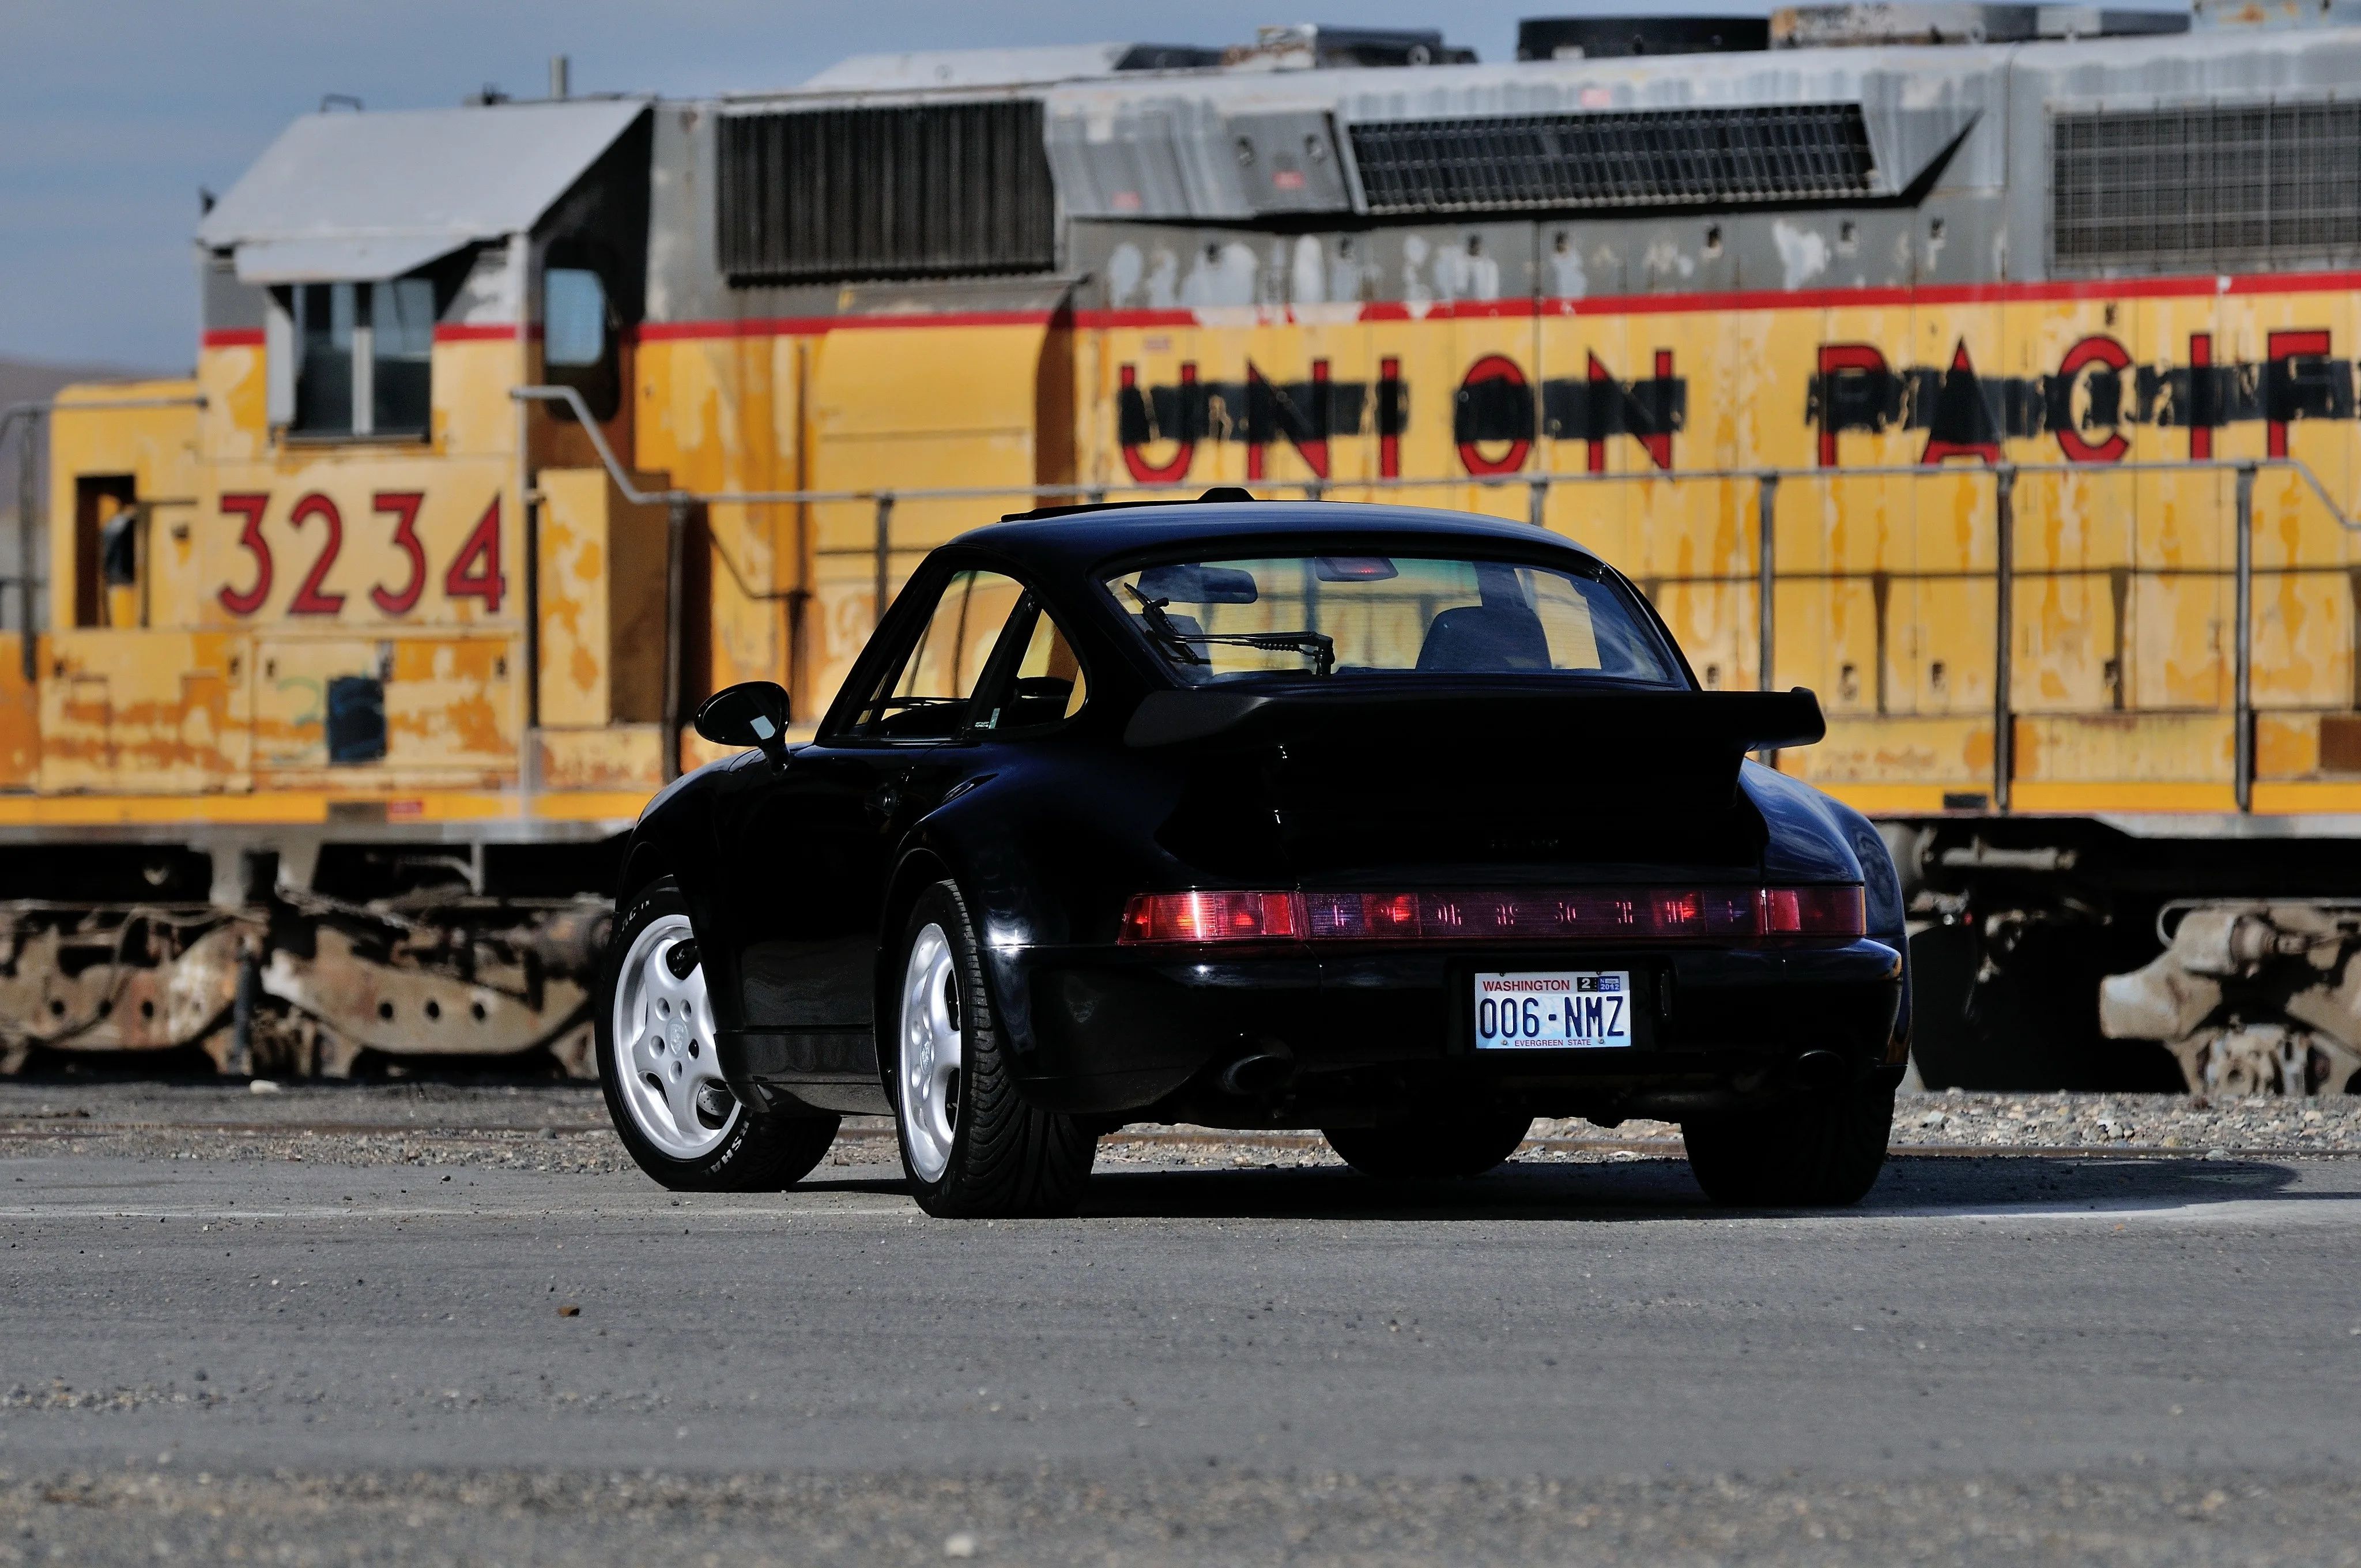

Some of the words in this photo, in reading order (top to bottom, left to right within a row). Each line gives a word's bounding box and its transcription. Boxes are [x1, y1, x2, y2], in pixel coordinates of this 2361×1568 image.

[1119, 348, 1674, 483] UNION
[218, 491, 506, 615] 3234
[1483, 979, 1570, 992] WASHINGTON
[1581, 978, 1590, 989] 2
[1480, 996, 1624, 1038] 006-NMZ
[1515, 1039, 1563, 1047] EVERGREEN
